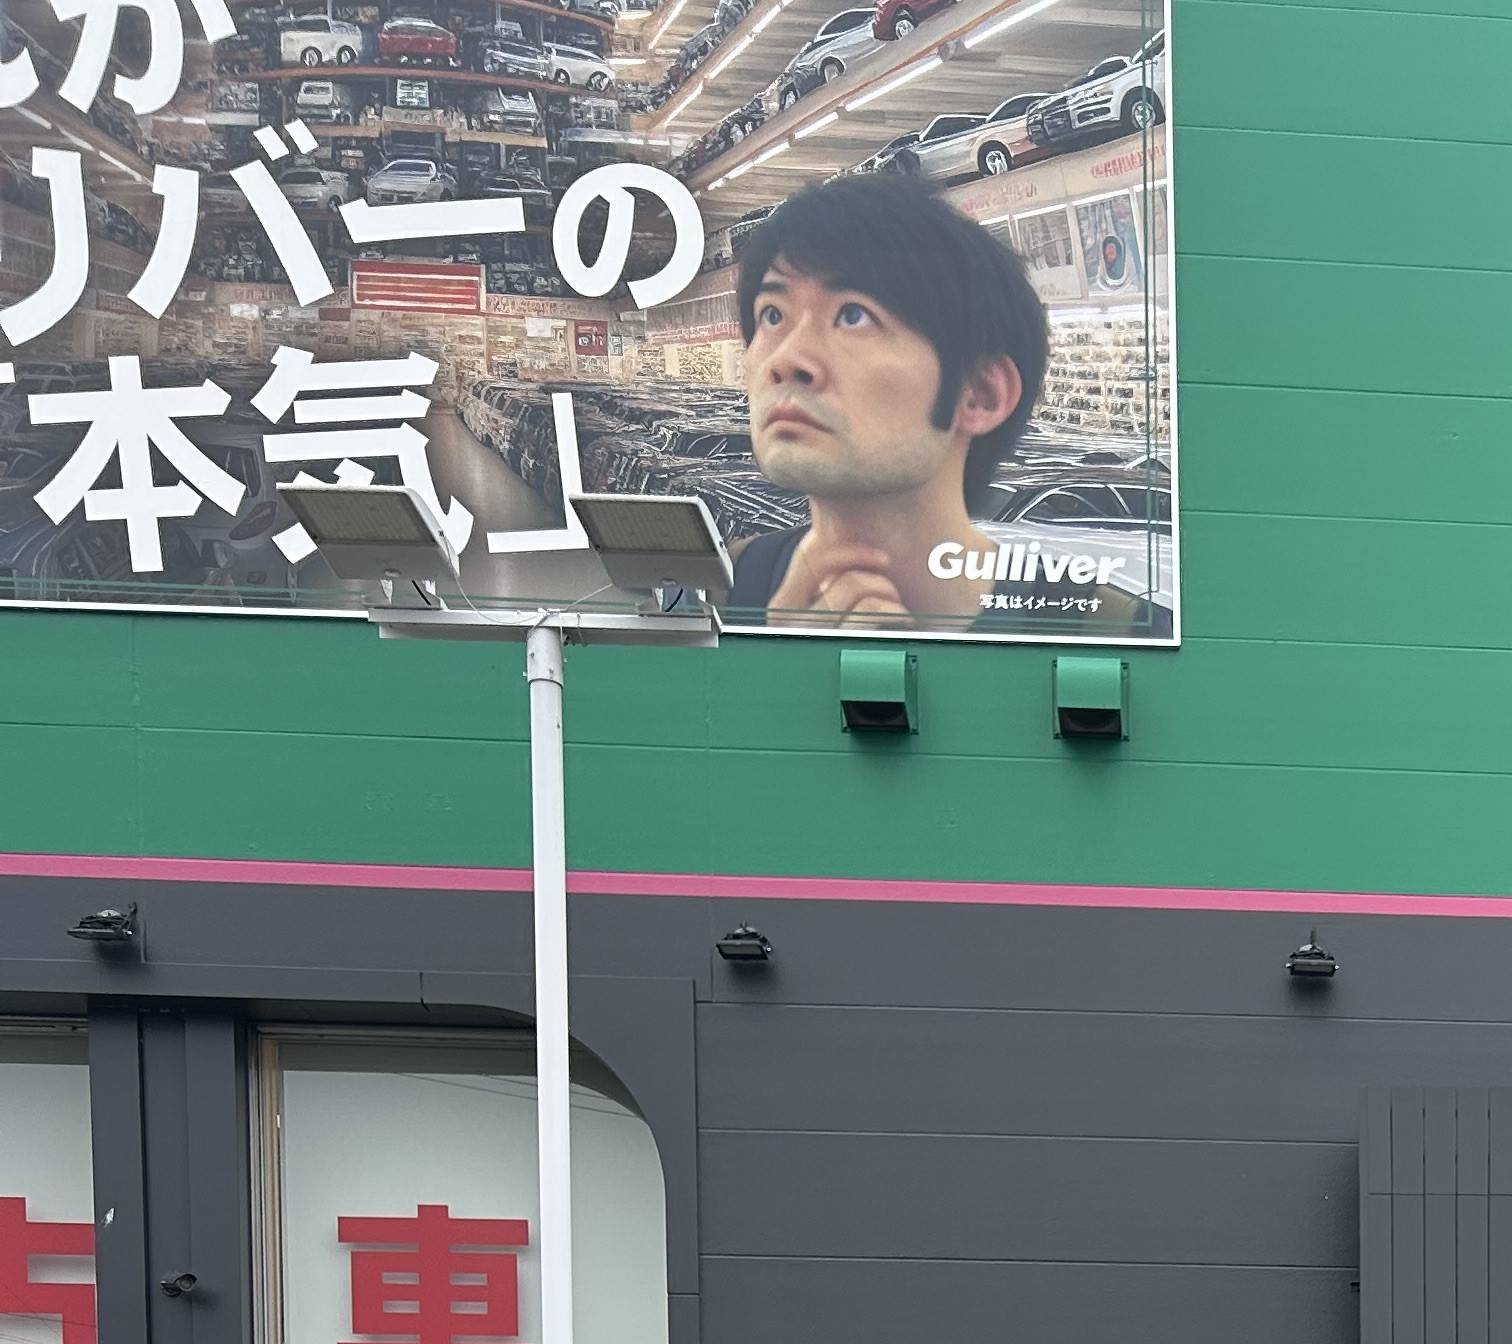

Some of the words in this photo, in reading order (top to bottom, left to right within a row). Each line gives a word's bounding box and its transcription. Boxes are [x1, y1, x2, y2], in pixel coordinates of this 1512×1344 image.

[927, 541, 1126, 585] Gulliver
[979, 594, 1102, 613] 写真はイメージです
